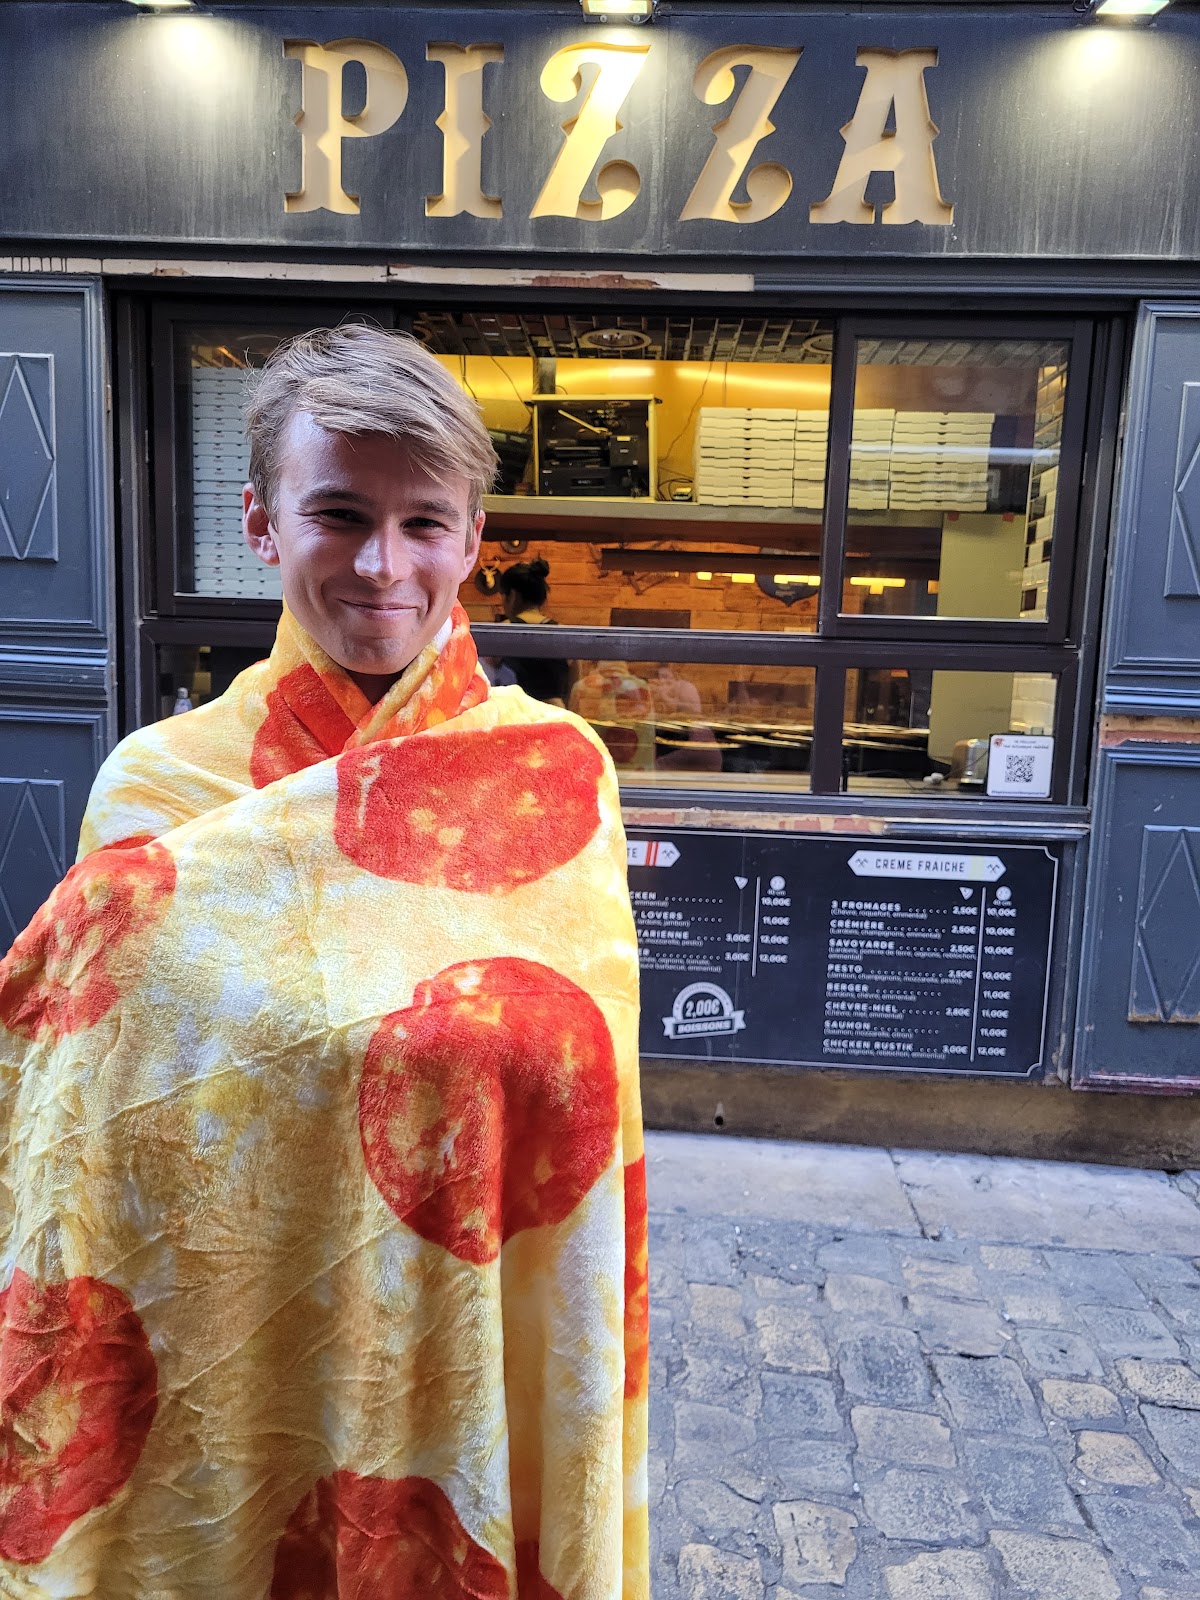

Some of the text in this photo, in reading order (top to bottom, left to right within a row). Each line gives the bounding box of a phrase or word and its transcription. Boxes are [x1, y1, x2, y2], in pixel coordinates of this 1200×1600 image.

[283, 38, 955, 226] PIZZA
[761, 897, 792, 907] 10,00€
[831, 900, 1017, 918] 3 FROMAGES 2,50€ 10,00€
[641, 910, 683, 920] LOVERS
[762, 916, 790, 926] 11,00€
[725, 932, 751, 943] 3,00€
[760, 934, 789, 945] 12,00€
[951, 925, 977, 935] 2,50€
[985, 926, 1016, 937] 10,00€
[828, 938, 1014, 956] SAVOYARDE 2,50€ 10,00€
[724, 951, 750, 962] 3,00€
[758, 953, 789, 964] 12,00€
[827, 963, 863, 974] PESTO
[982, 971, 1012, 981] 10,00€
[826, 982, 1011, 1000] BERGER 11,00€
[685, 998, 720, 1019] 2,00€
[981, 1009, 1010, 1019] 11,00€
[677, 1020, 731, 1034] BOISSONS
[824, 1019, 1008, 1038] SAUMON 11,00€
[823, 1038, 871, 1049] CHICKEN
[873, 1041, 914, 1052] RUSTIK
[977, 1046, 1006, 1056] 12,00€
